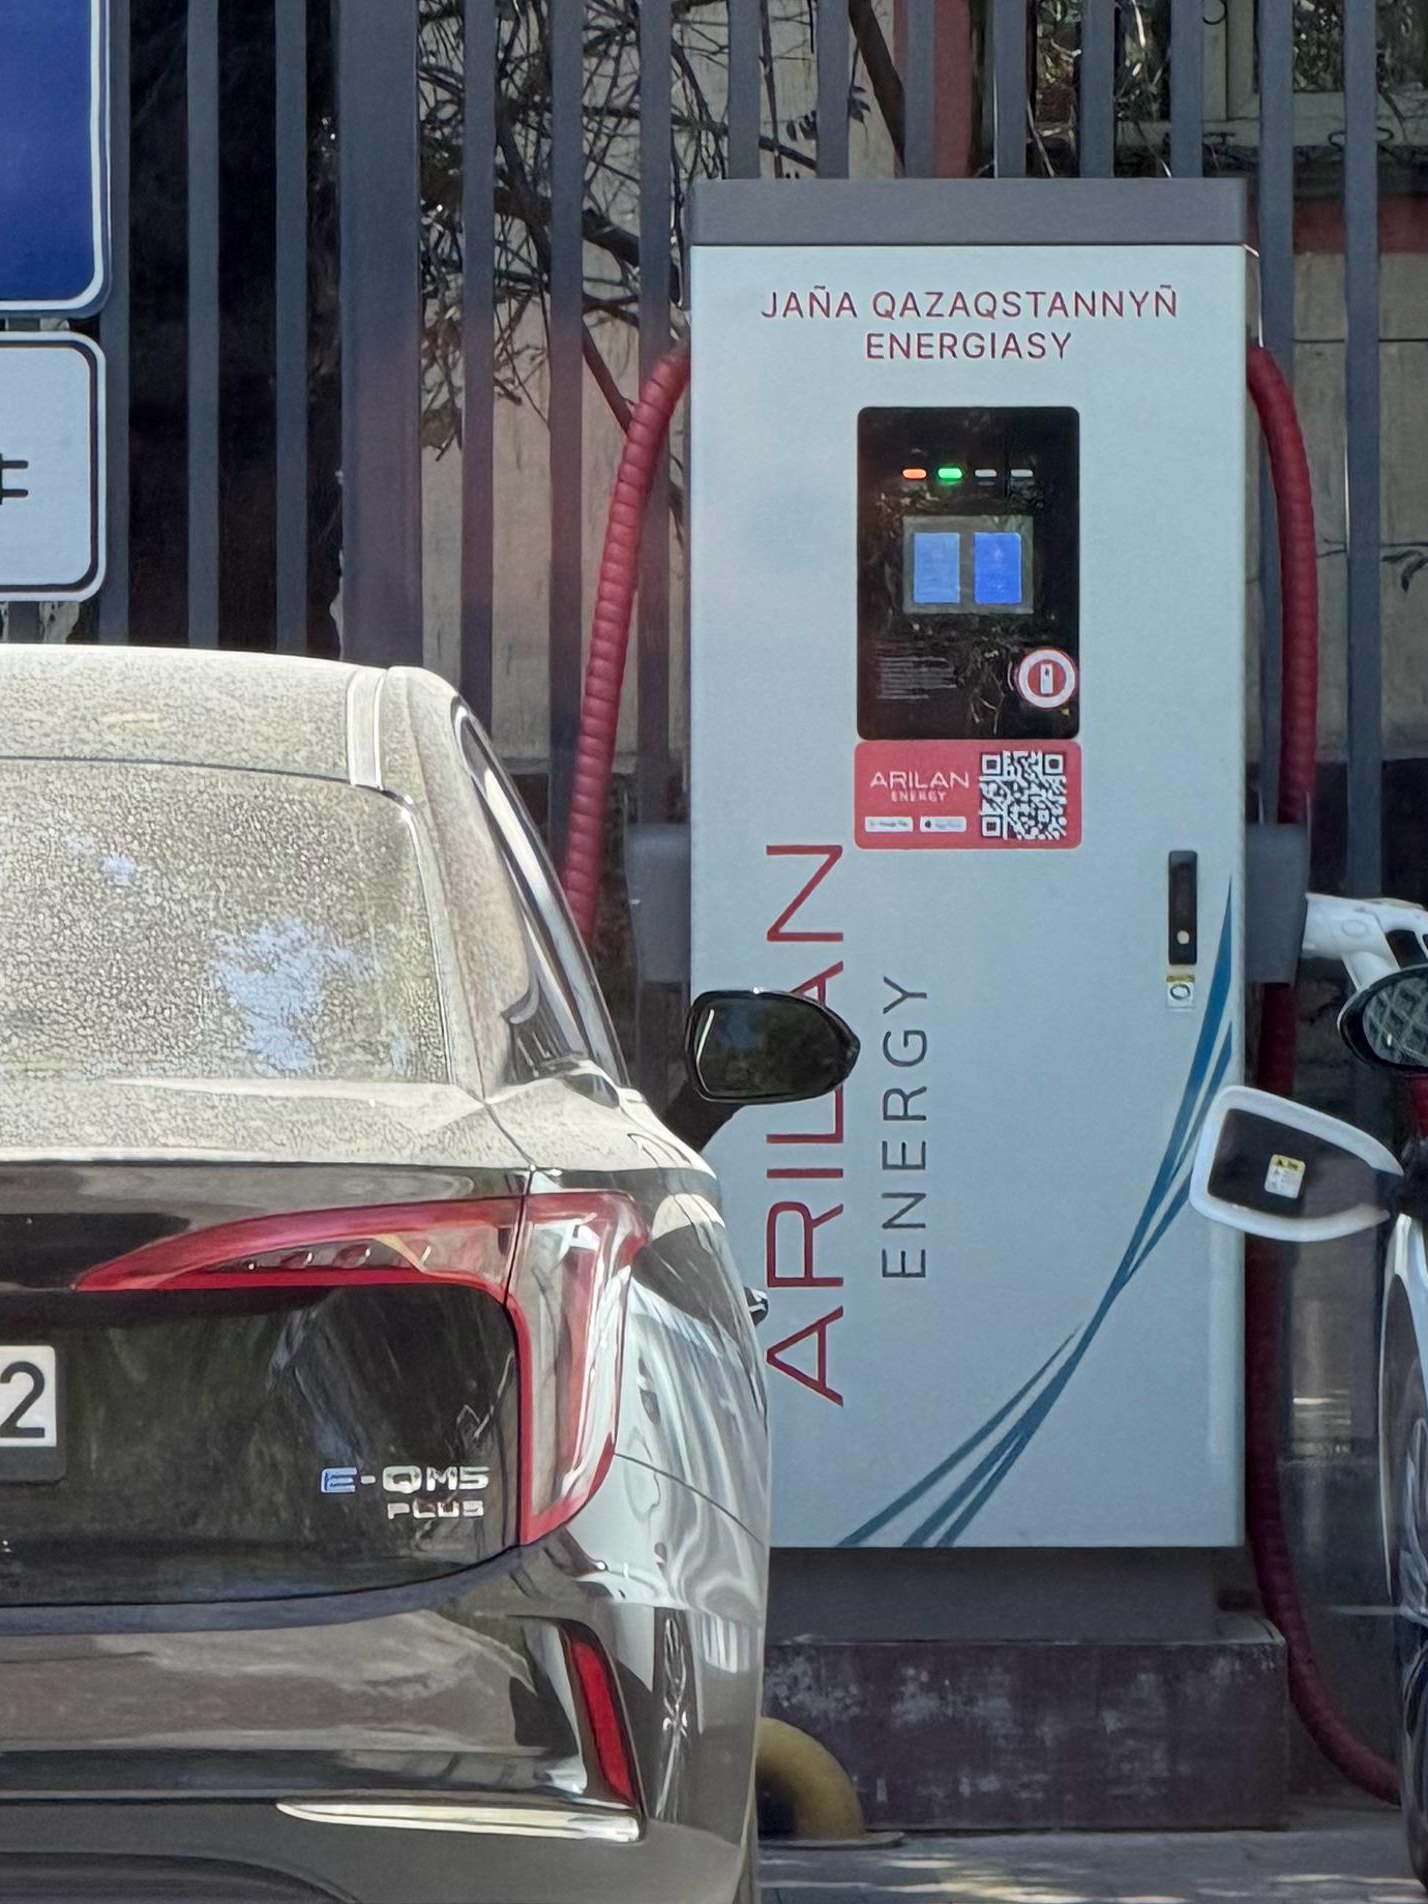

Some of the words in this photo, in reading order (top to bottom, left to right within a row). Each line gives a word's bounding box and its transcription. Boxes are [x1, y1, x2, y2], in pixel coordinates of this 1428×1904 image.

[761, 284, 858, 319] JAÑA
[872, 284, 1177, 320] QAZAQSTANNYÑ
[866, 332, 1072, 359] ENERGIASY
[870, 771, 970, 789] ARILAN
[891, 790, 947, 802] ENERGY
[882, 975, 928, 1278] ENERGY
[387, 1498, 485, 1520] PLUS
